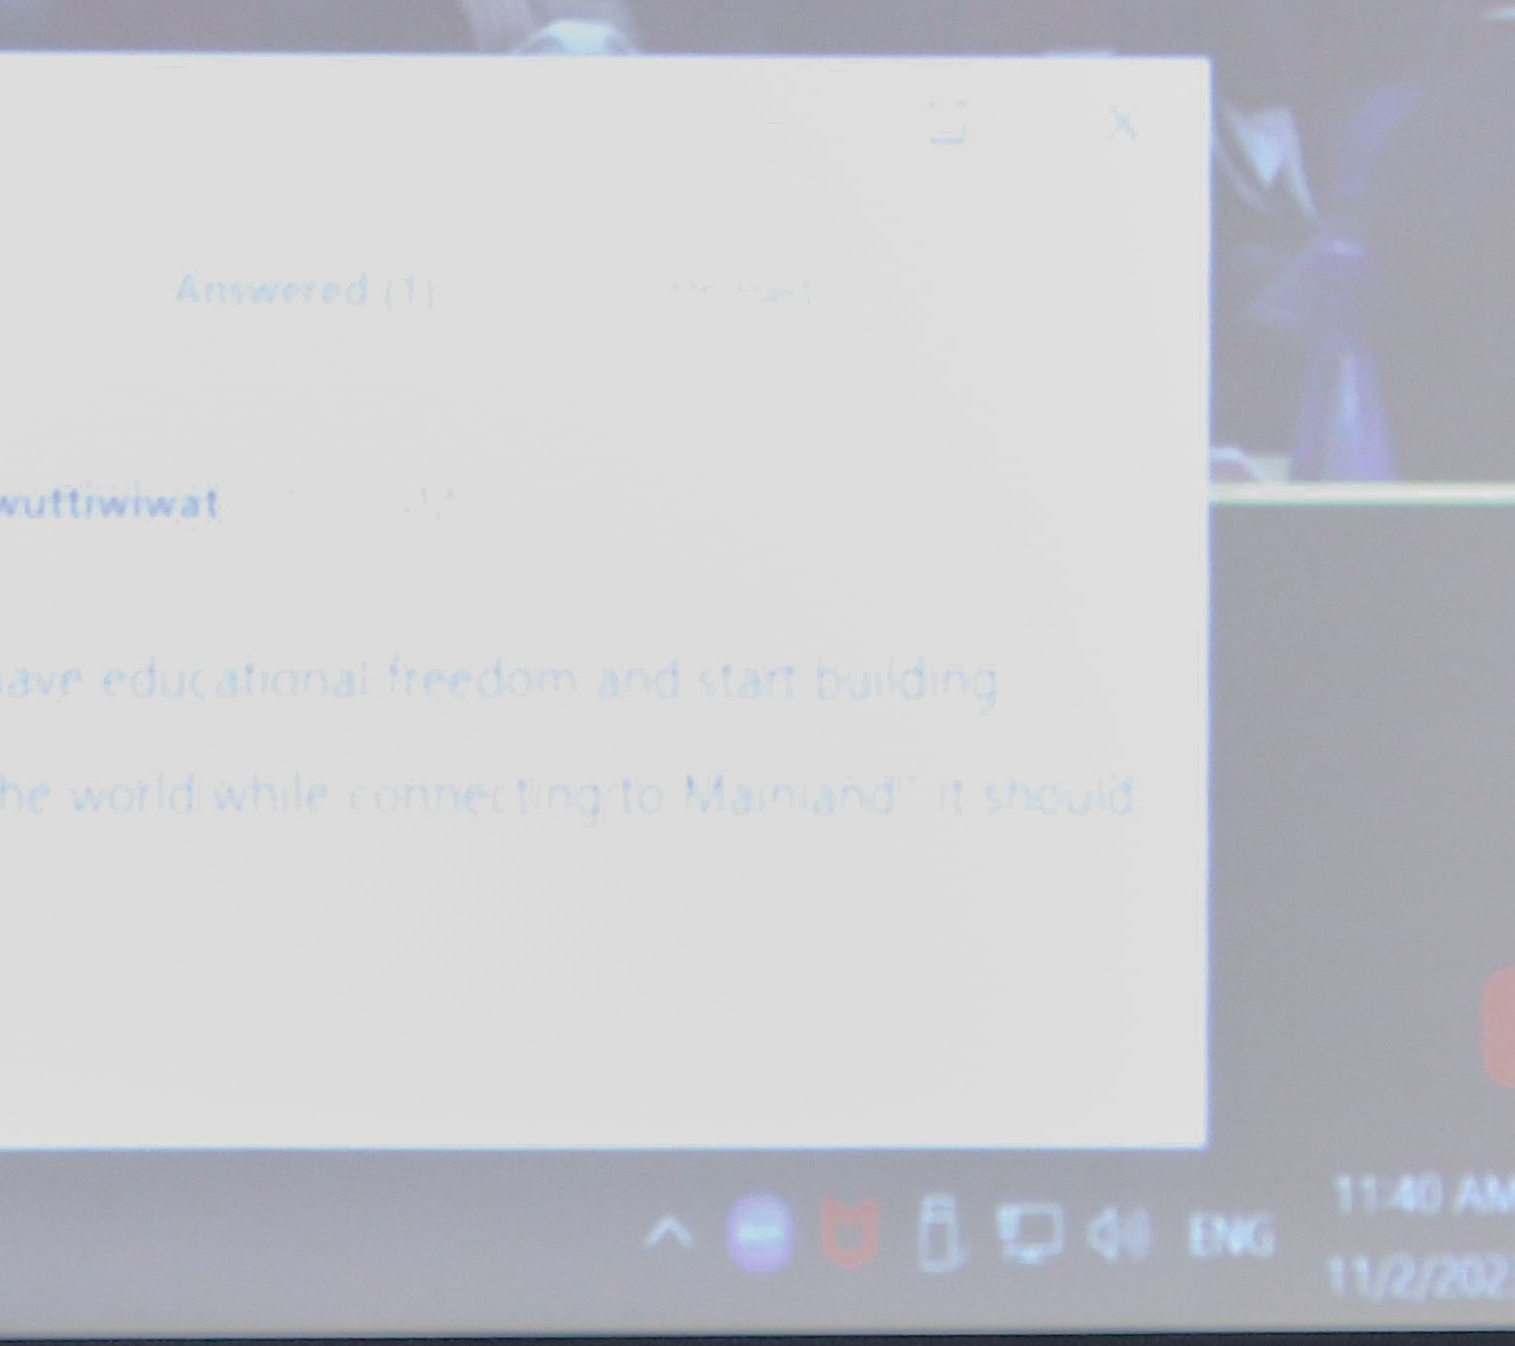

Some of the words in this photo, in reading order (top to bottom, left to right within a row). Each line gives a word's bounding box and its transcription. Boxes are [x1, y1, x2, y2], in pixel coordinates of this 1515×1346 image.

[174, 272, 369, 307] Answered
[101, 656, 368, 699] educational
[388, 654, 577, 698] freedom
[596, 659, 680, 699] and
[699, 659, 796, 700] start
[71, 772, 198, 815] world
[214, 774, 329, 814] while
[348, 778, 602, 827] connecting
[620, 777, 664, 816] to
[984, 775, 1134, 816] should
[1188, 1212, 1276, 1259] ENG
